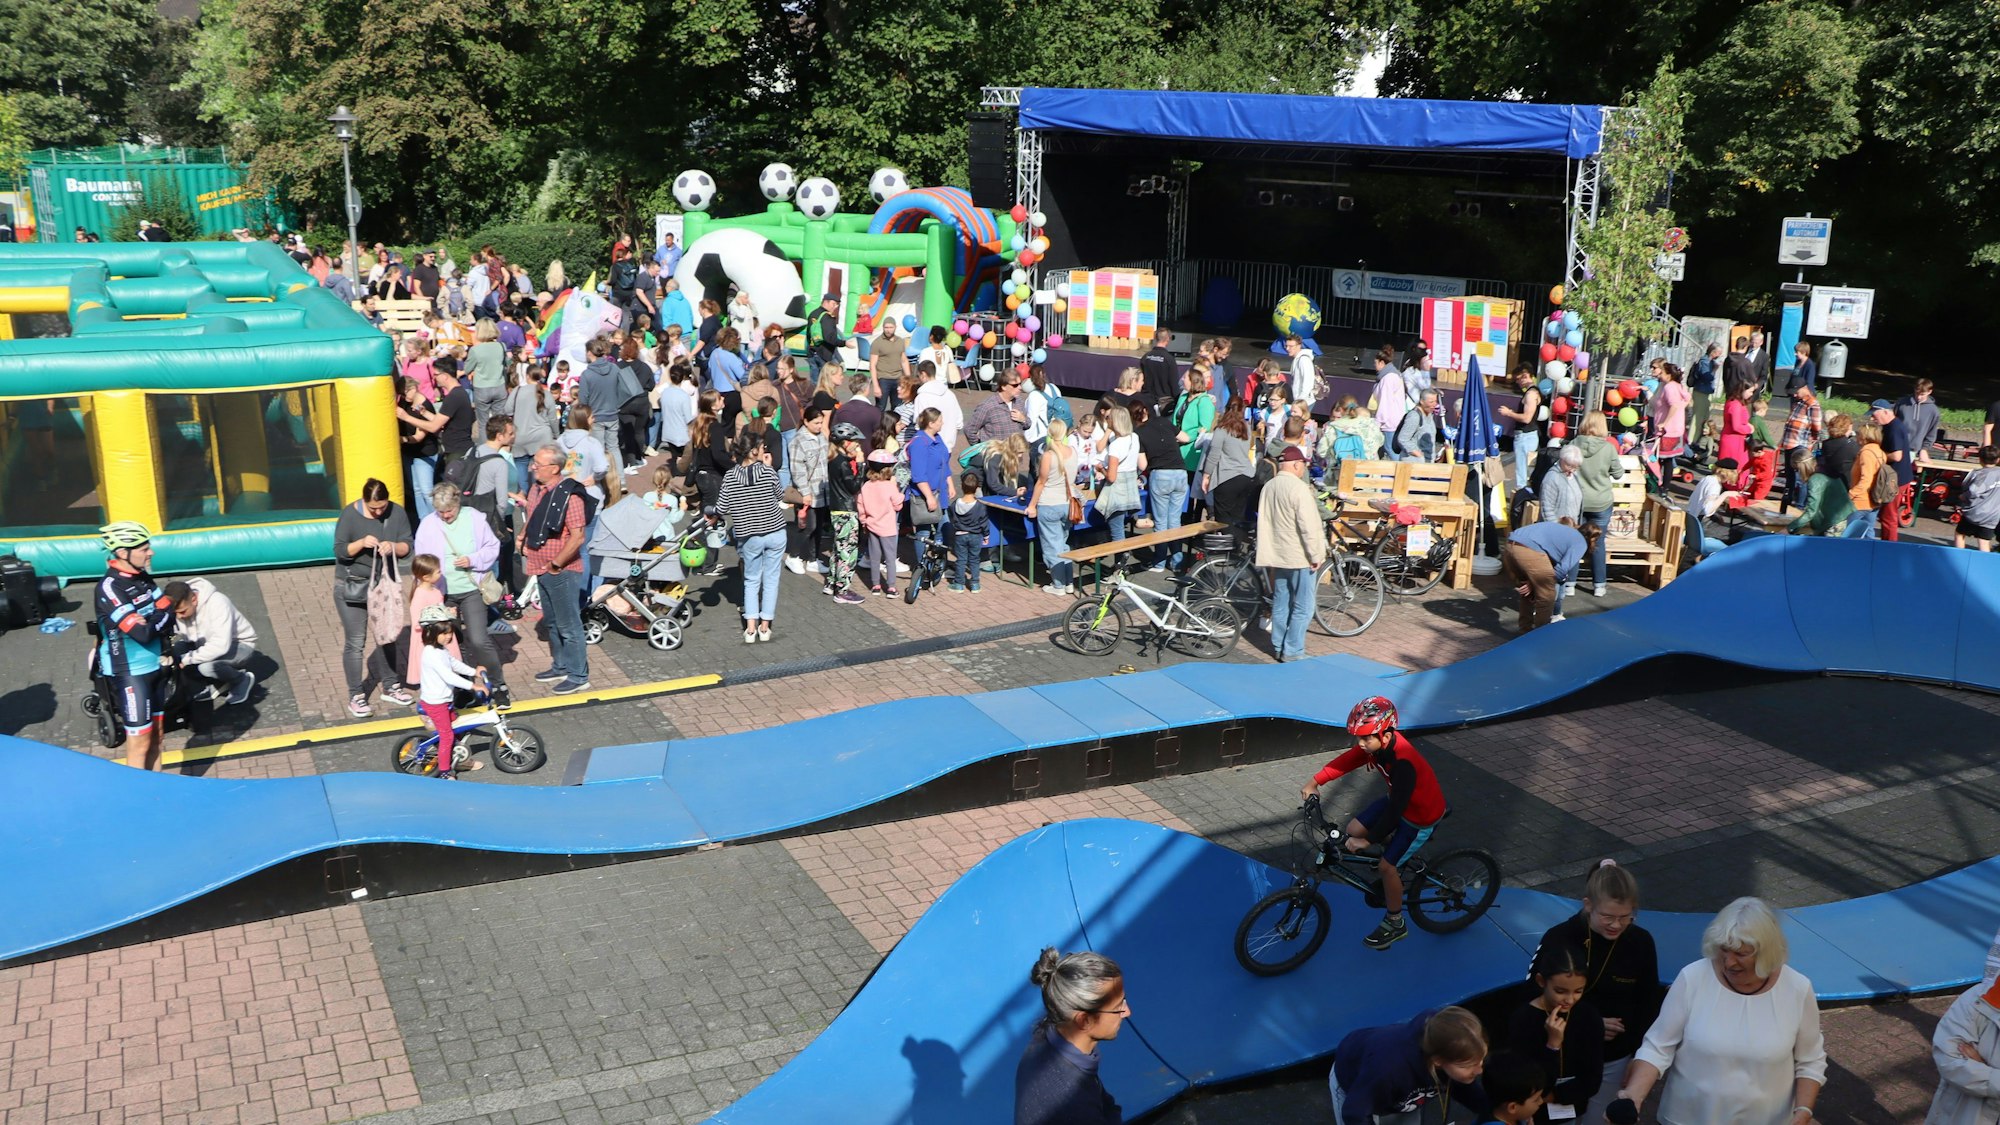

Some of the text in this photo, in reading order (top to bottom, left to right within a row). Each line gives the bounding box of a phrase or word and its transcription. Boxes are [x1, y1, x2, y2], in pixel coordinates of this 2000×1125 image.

[65, 177, 143, 192] Baumann
[1787, 221, 1827, 230] PARKSCHEIN-
[1792, 229, 1819, 237] AUTOMAT
[1372, 278, 1458, 293] die lobby für kinder
